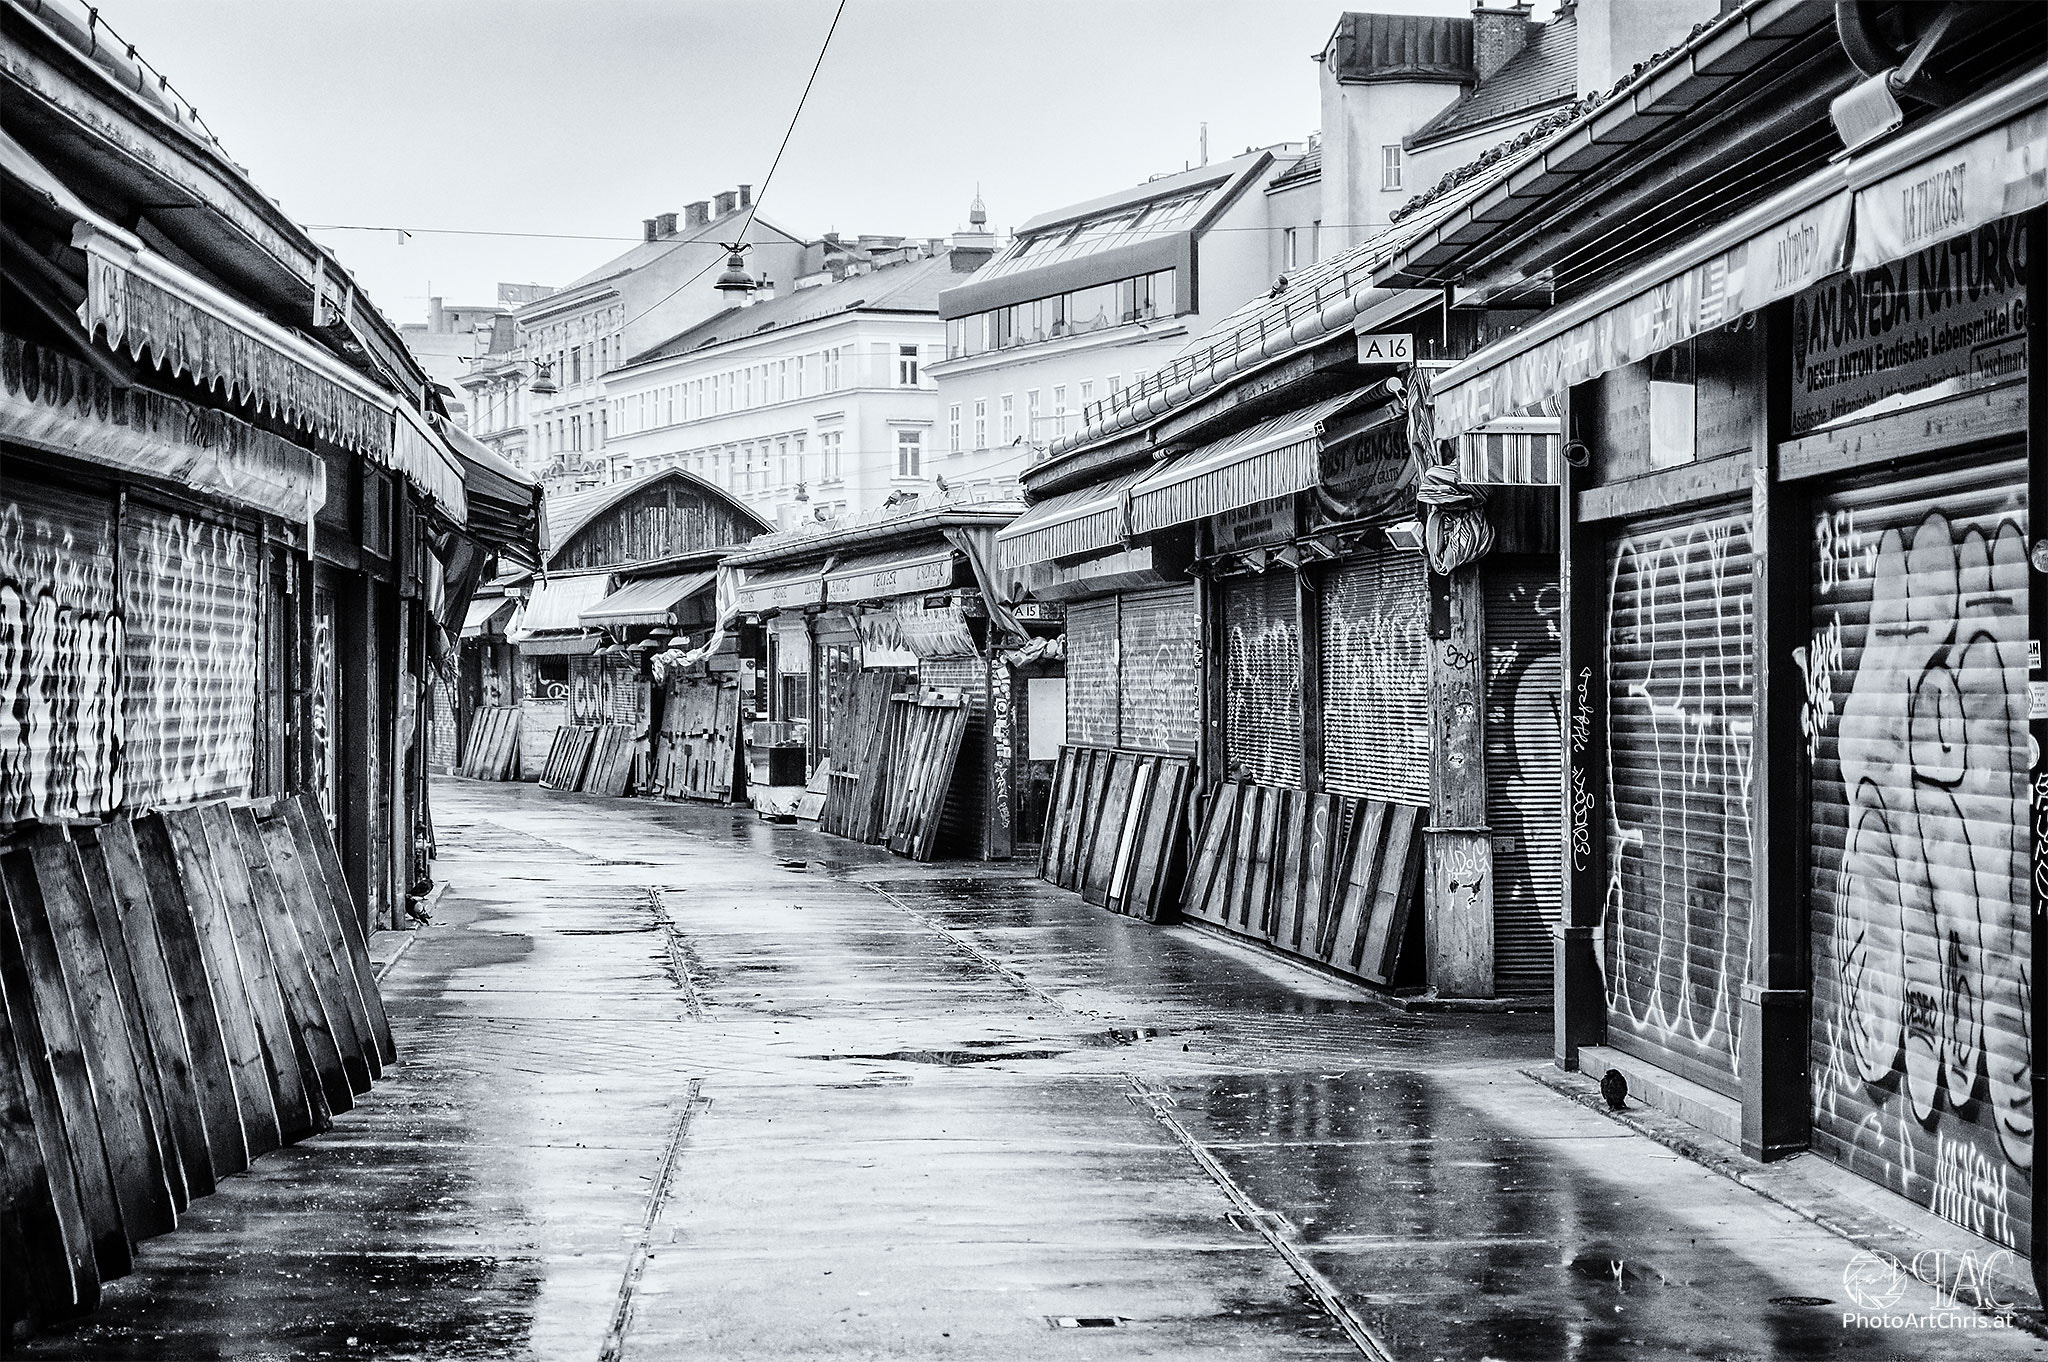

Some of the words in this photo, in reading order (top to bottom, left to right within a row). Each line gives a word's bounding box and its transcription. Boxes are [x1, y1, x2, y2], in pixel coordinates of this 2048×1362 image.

[1808, 260, 1911, 354] AYURVEDA
[1366, 339, 1384, 358] A
[1388, 338, 1407, 358] 16
[1807, 359, 1835, 393] DESHI
[1838, 347, 1873, 383] ANTON
[1876, 336, 1928, 372] Exotische
[1931, 303, 2009, 353] Lebensmittel
[1014, 607, 1024, 617] A
[1026, 605, 1036, 617] 15
